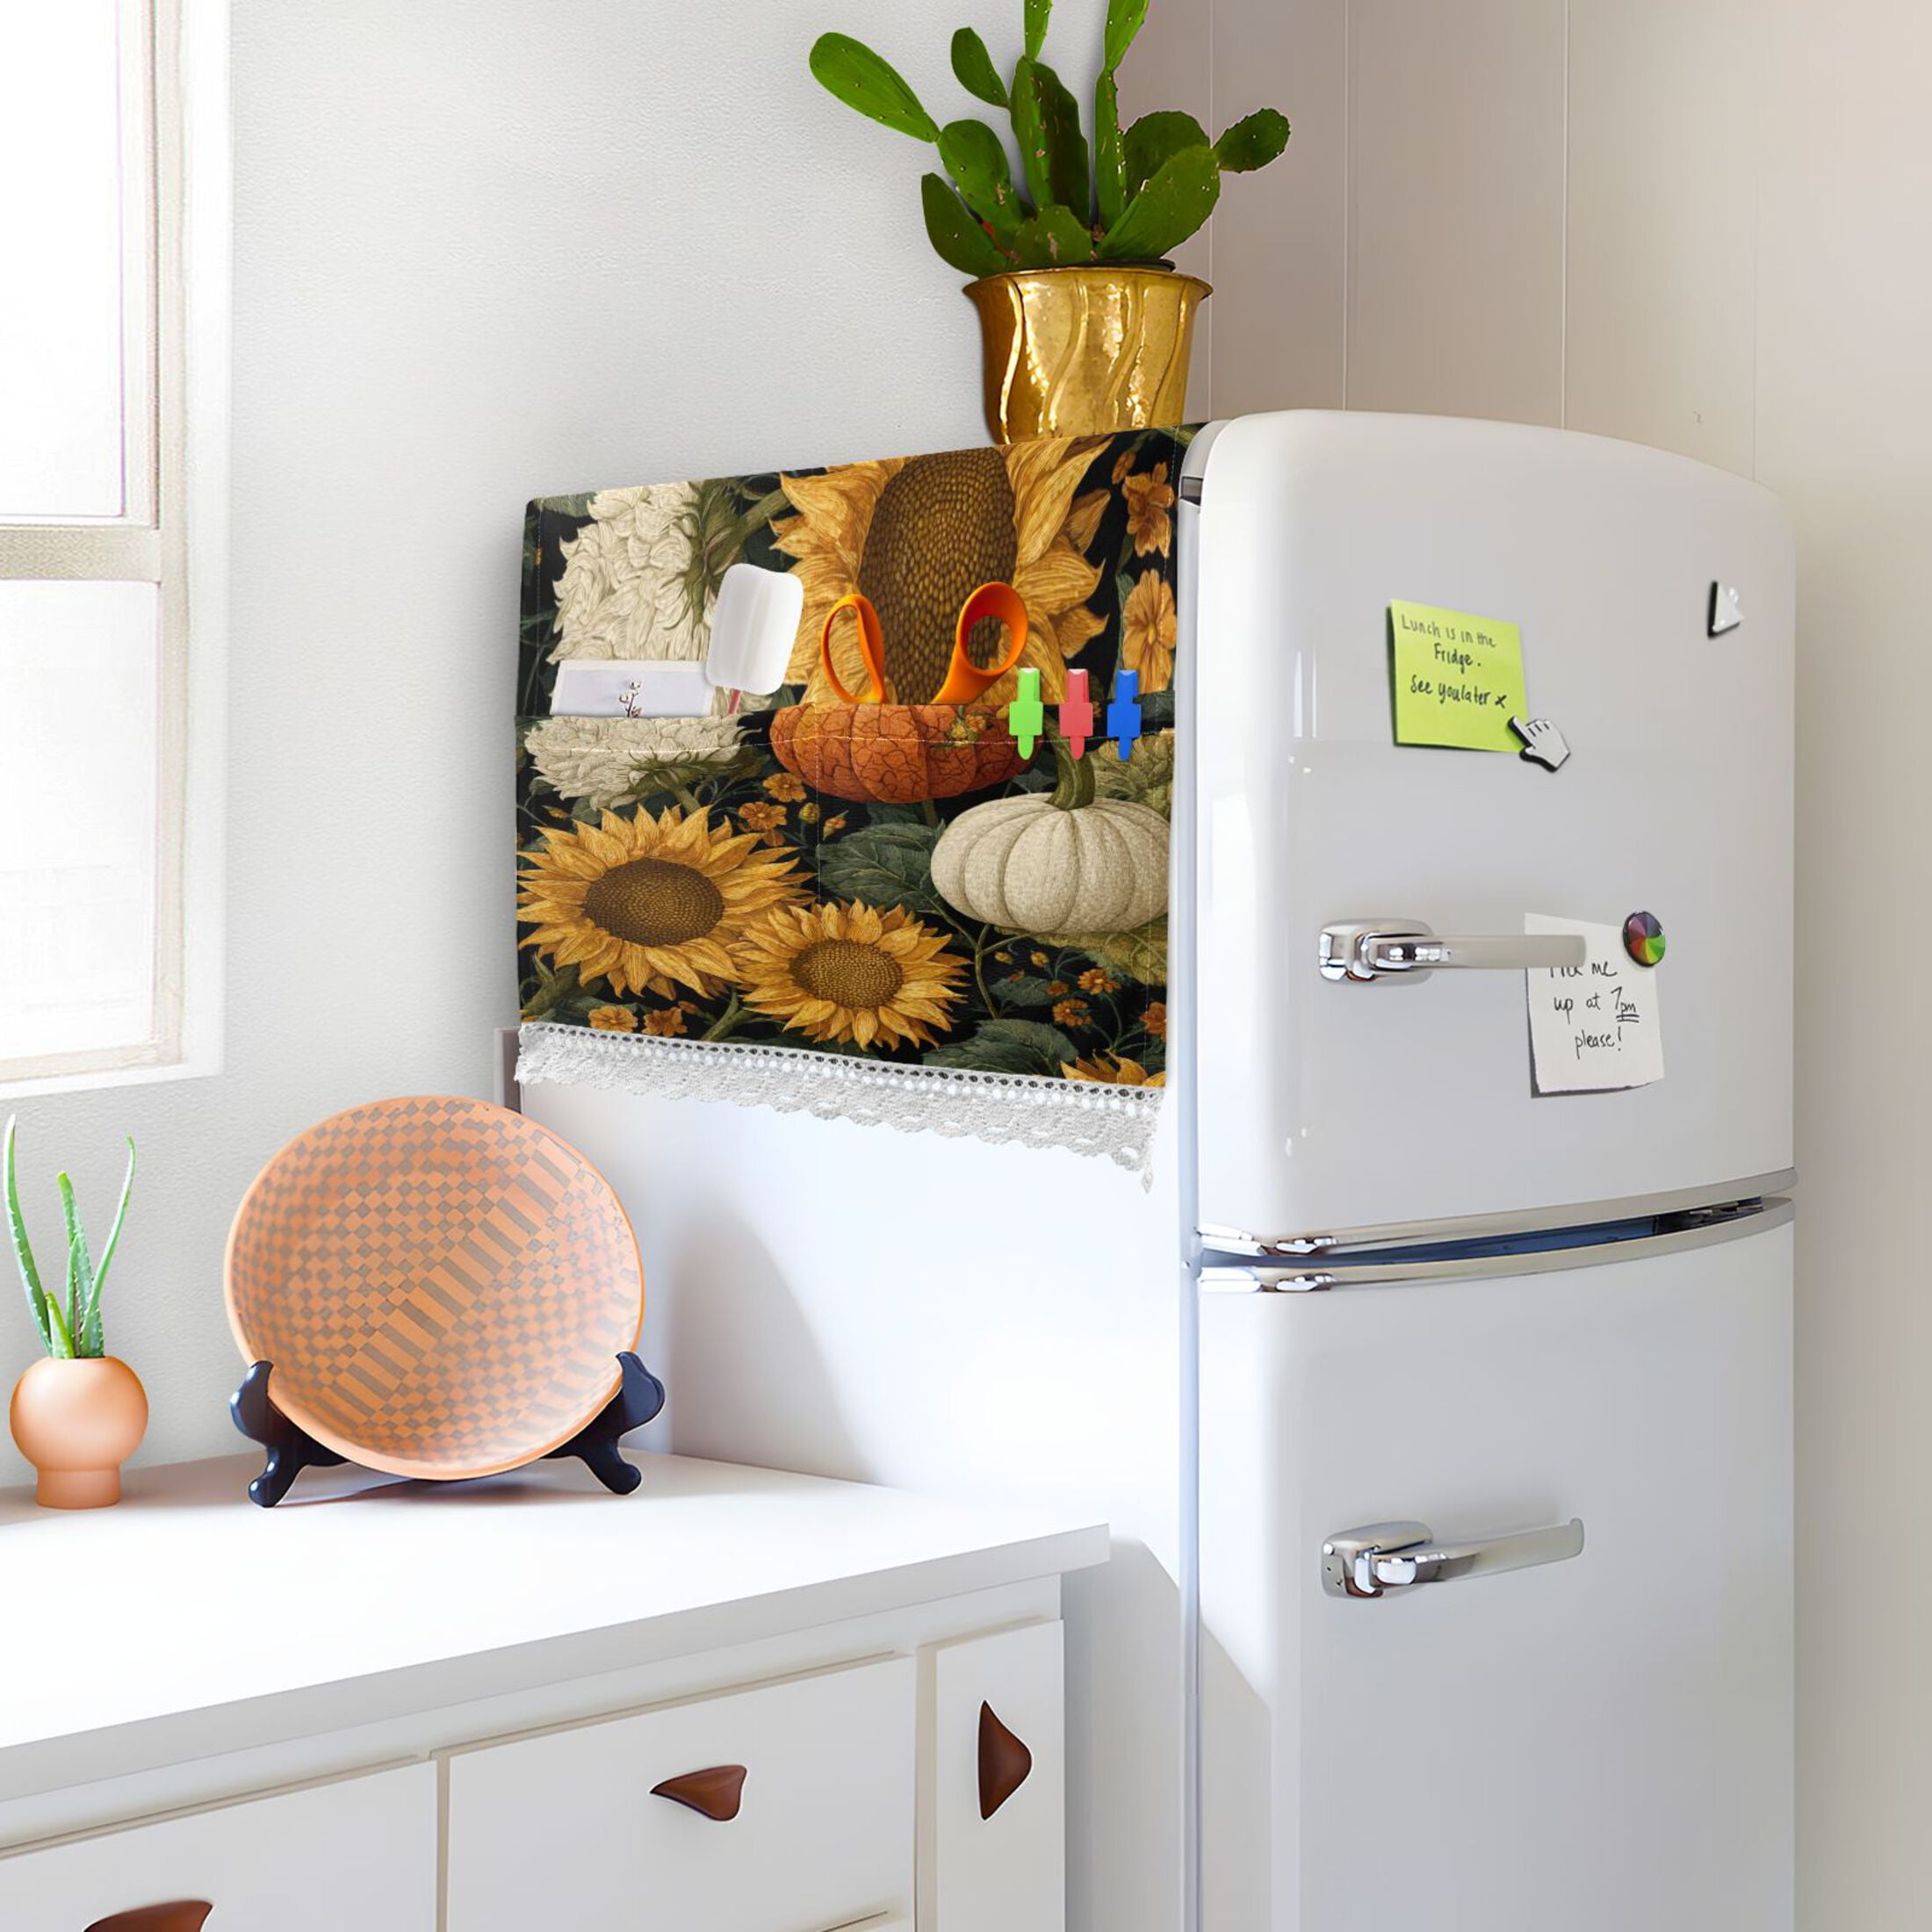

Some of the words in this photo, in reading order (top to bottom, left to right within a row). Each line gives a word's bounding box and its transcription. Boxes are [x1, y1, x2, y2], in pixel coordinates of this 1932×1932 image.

[1402, 615, 1440, 638] Lunch
[1460, 631, 1474, 644] in
[1477, 632, 1496, 647] the
[1410, 674, 1433, 695] See
[1554, 997, 1574, 1025] up
[1586, 992, 1601, 1011] at
[1575, 1026, 1622, 1060] please!
